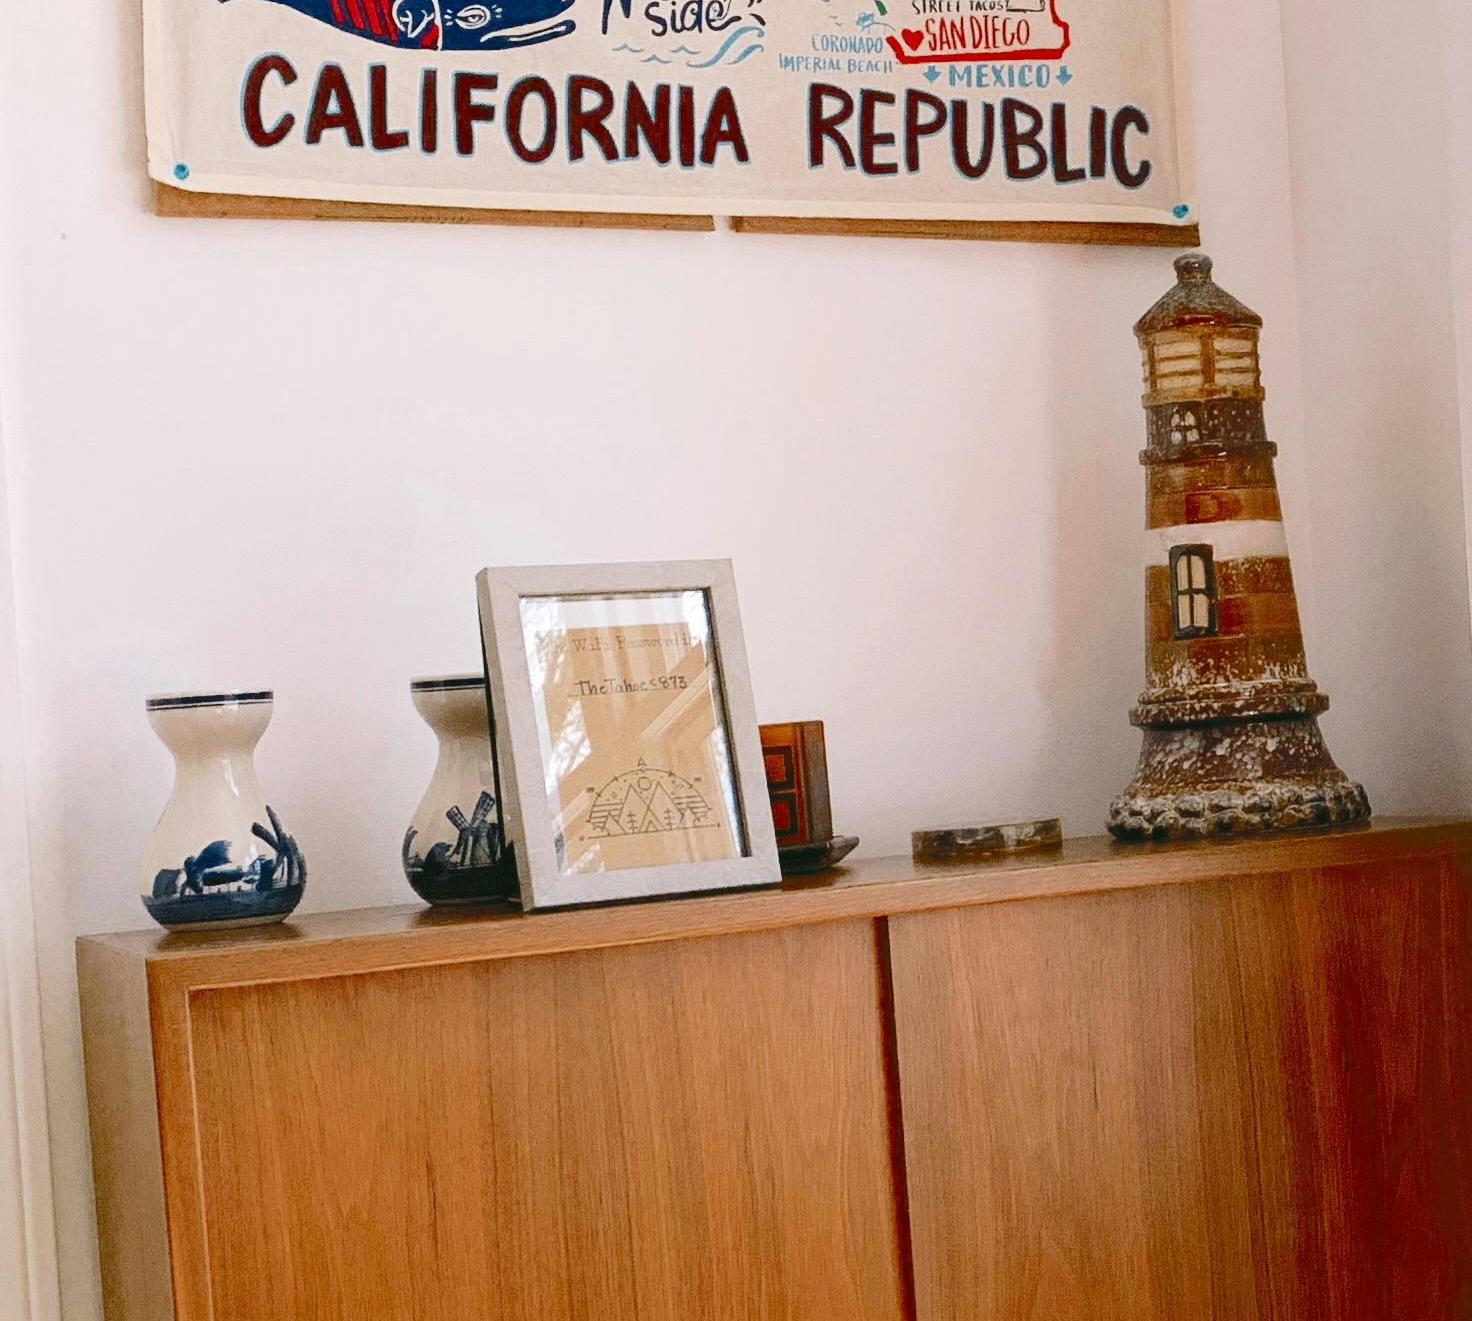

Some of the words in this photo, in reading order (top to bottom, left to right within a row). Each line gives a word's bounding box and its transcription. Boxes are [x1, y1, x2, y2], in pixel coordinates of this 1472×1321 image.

[969, 0, 1004, 13] TACOS
[812, 34, 884, 53] CORONADO
[924, 17, 967, 51] SAN
[970, 15, 1030, 49] DIEGO
[779, 54, 841, 72] IMPERIAL
[848, 57, 893, 74] BEACH
[948, 64, 1050, 89] MEXICO
[241, 51, 751, 169] CALIFORNIA
[806, 80, 1155, 189] REPUBLIC
